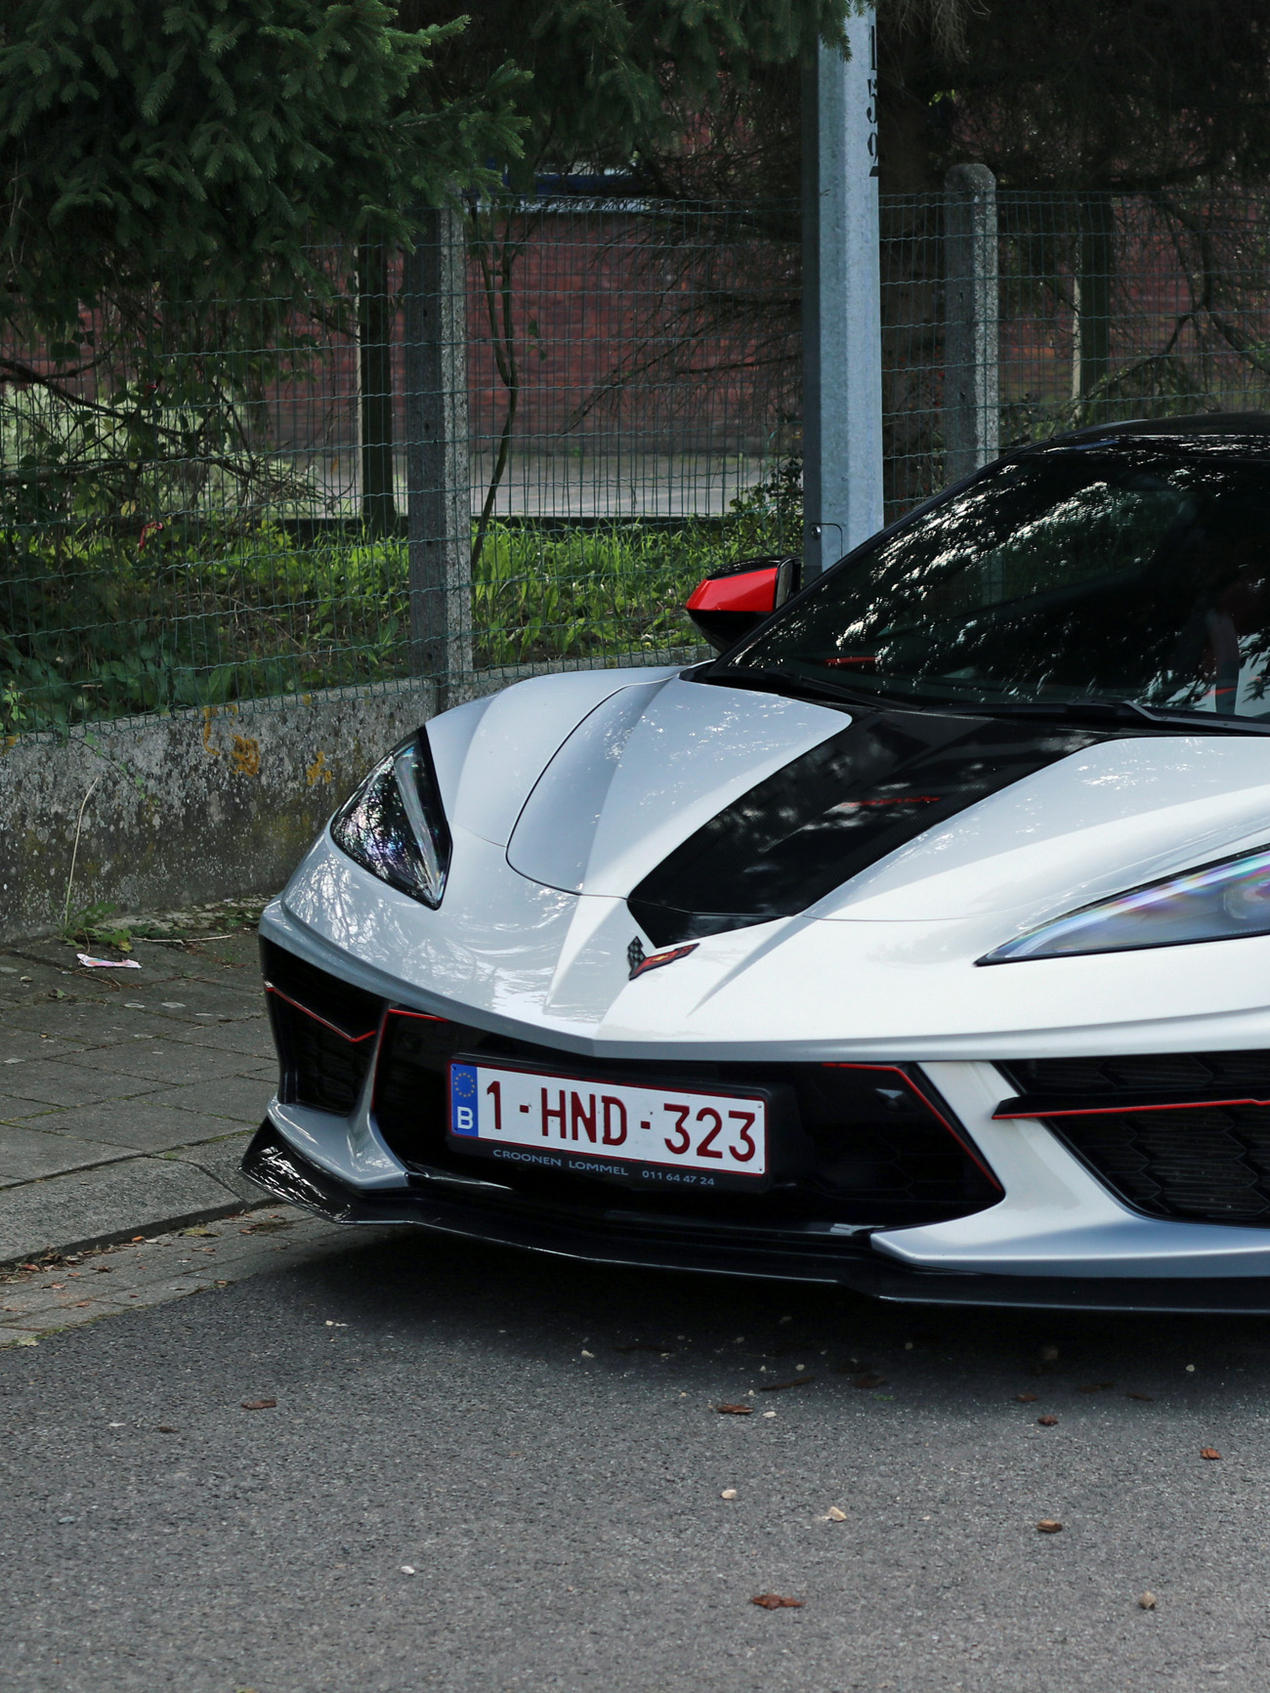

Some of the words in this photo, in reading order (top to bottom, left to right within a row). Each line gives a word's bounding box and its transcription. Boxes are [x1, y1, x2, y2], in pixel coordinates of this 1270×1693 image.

[457, 1106, 474, 1130] B
[493, 1149, 562, 1167] CROONEN
[568, 1160, 629, 1176] LOMMEL
[642, 1170, 663, 1181] 011
[666, 1173, 680, 1183] 64
[683, 1175, 697, 1184] 47
[699, 1177, 715, 1186] 24
